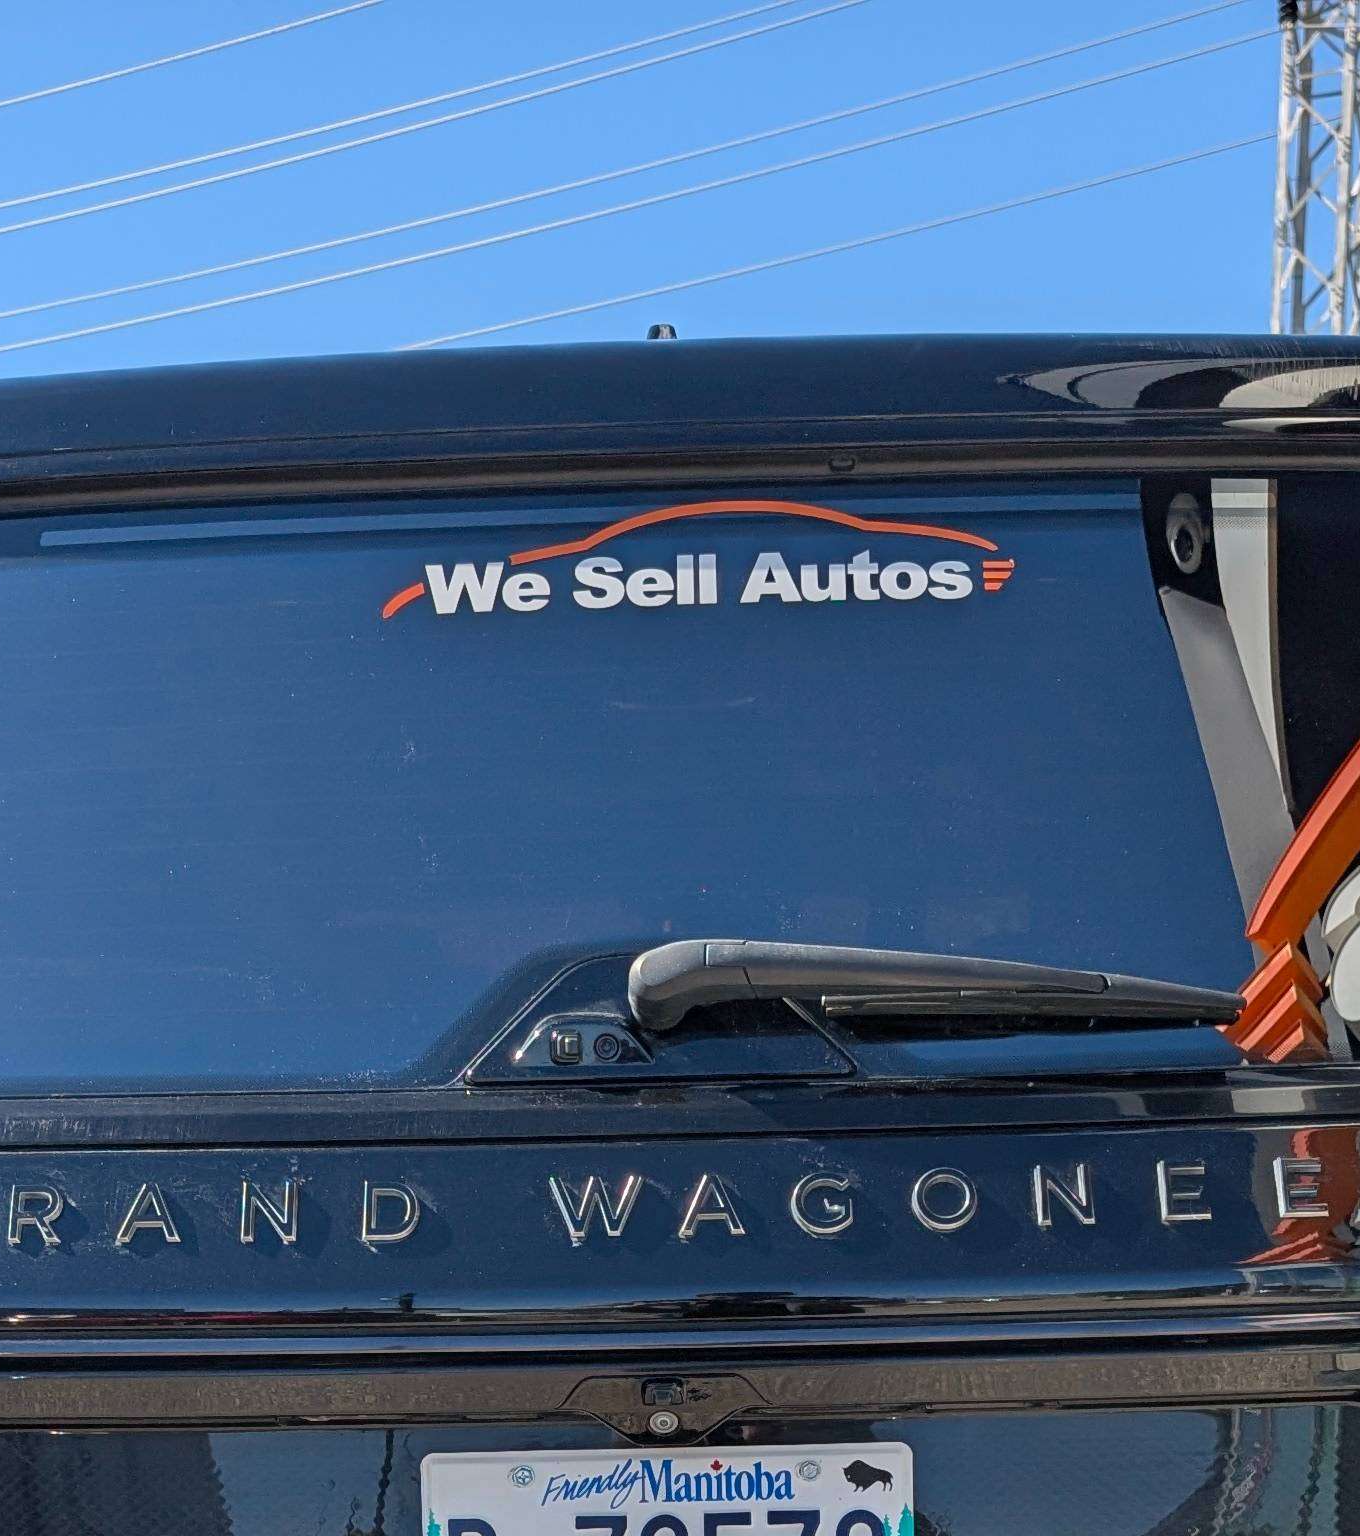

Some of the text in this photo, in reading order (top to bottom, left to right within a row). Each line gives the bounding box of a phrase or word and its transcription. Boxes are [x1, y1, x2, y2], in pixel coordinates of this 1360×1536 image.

[424, 549, 974, 615] We Sell Autos
[542, 1458, 796, 1510] Friendly Manitoba
